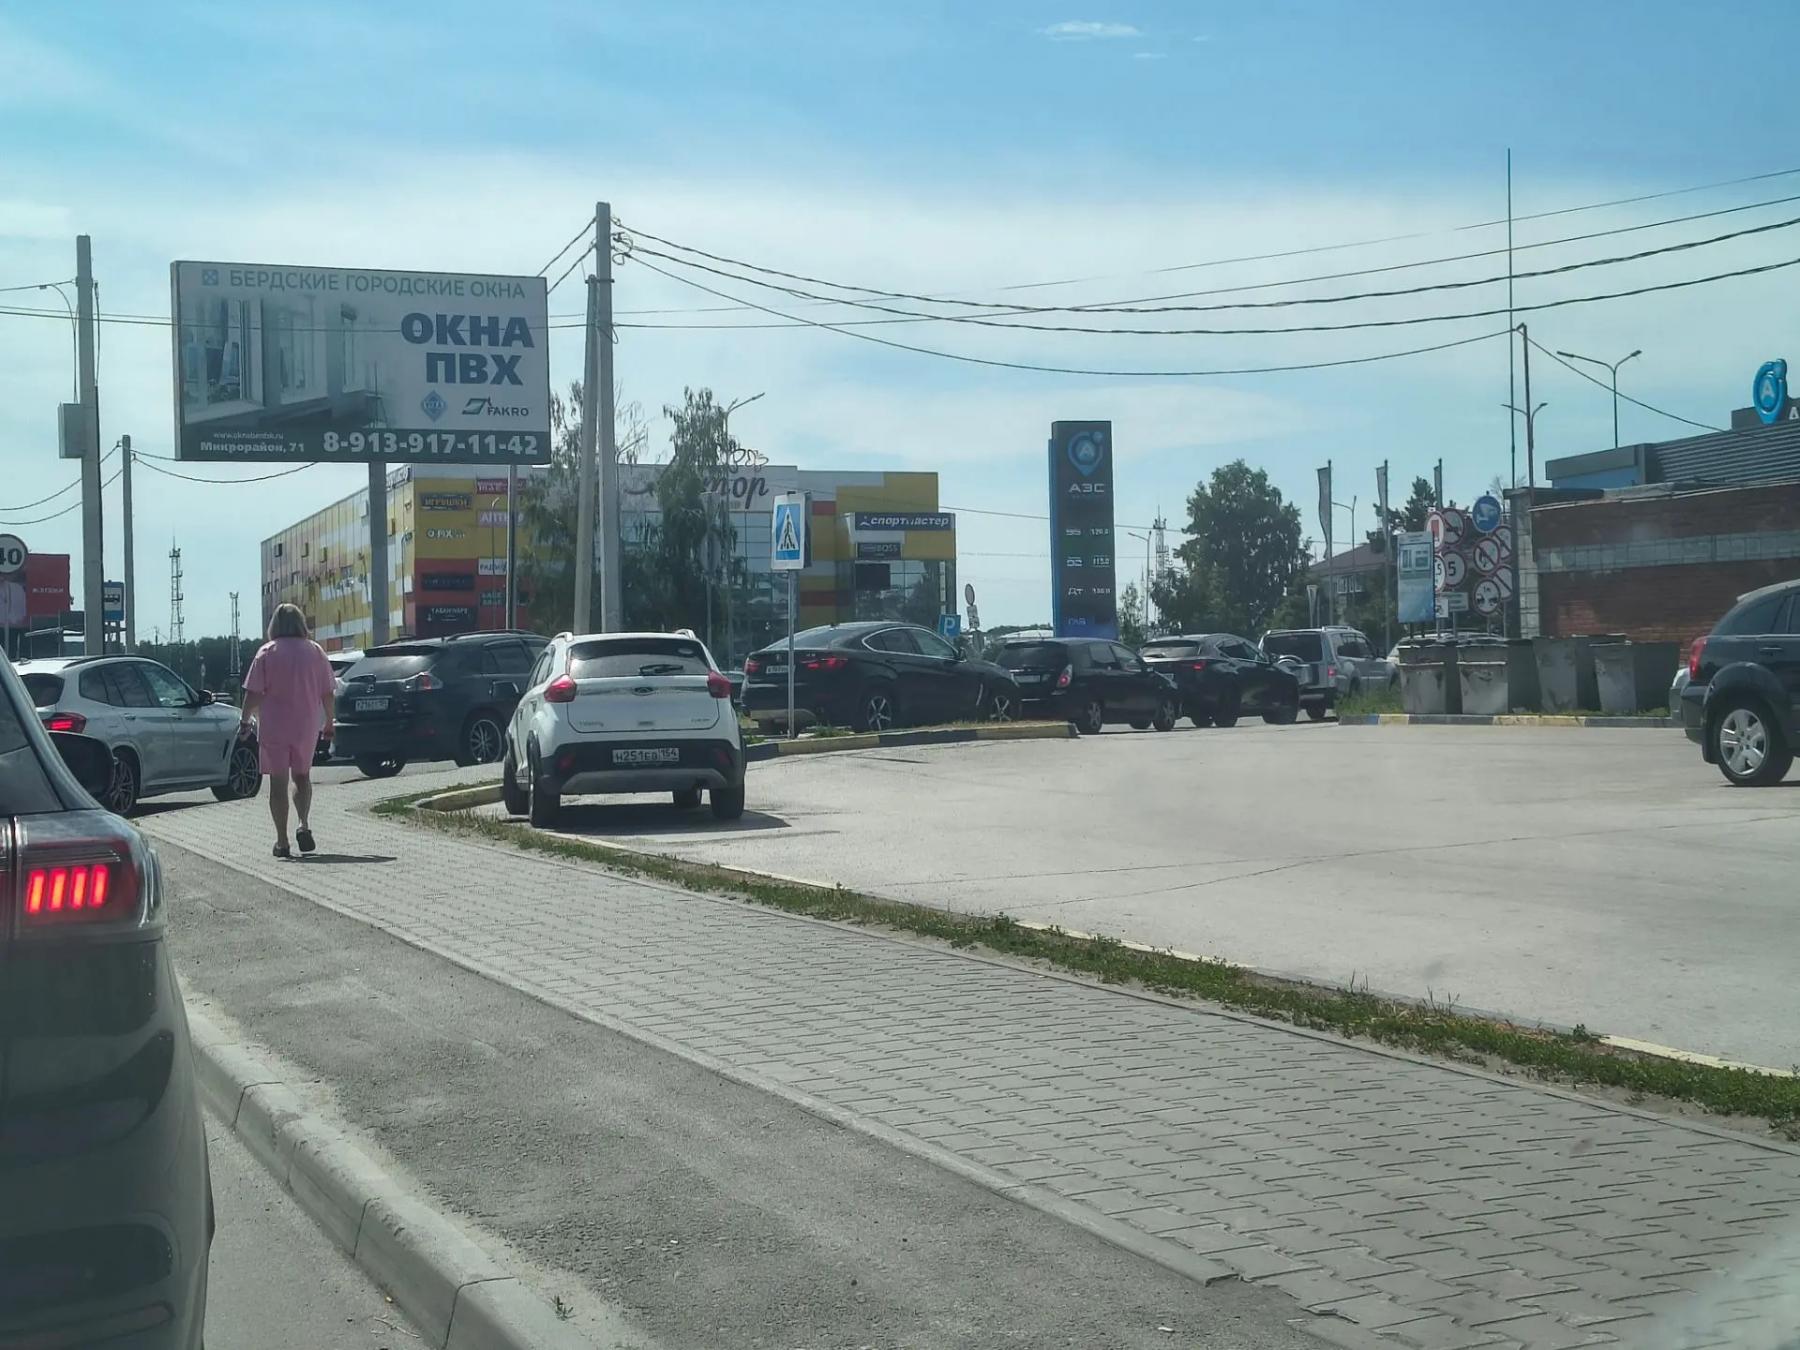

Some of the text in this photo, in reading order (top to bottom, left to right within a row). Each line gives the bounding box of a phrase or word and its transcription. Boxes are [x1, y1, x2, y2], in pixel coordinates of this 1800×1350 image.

[229, 269, 526, 298] БЕРДСКИЕ ГОРОДСКИЕ ОКНА
[401, 312, 535, 348] ОКНА
[426, 352, 524, 385] ПВХ
[487, 406, 529, 417] FAKRO
[200, 441, 304, 453] Микрорайон, 71
[323, 431, 538, 455] 8-913-917-11-42
[1069, 483, 1105, 493] АЗС
[1448, 561, 1457, 576] 5
[943, 616, 955, 634] P
